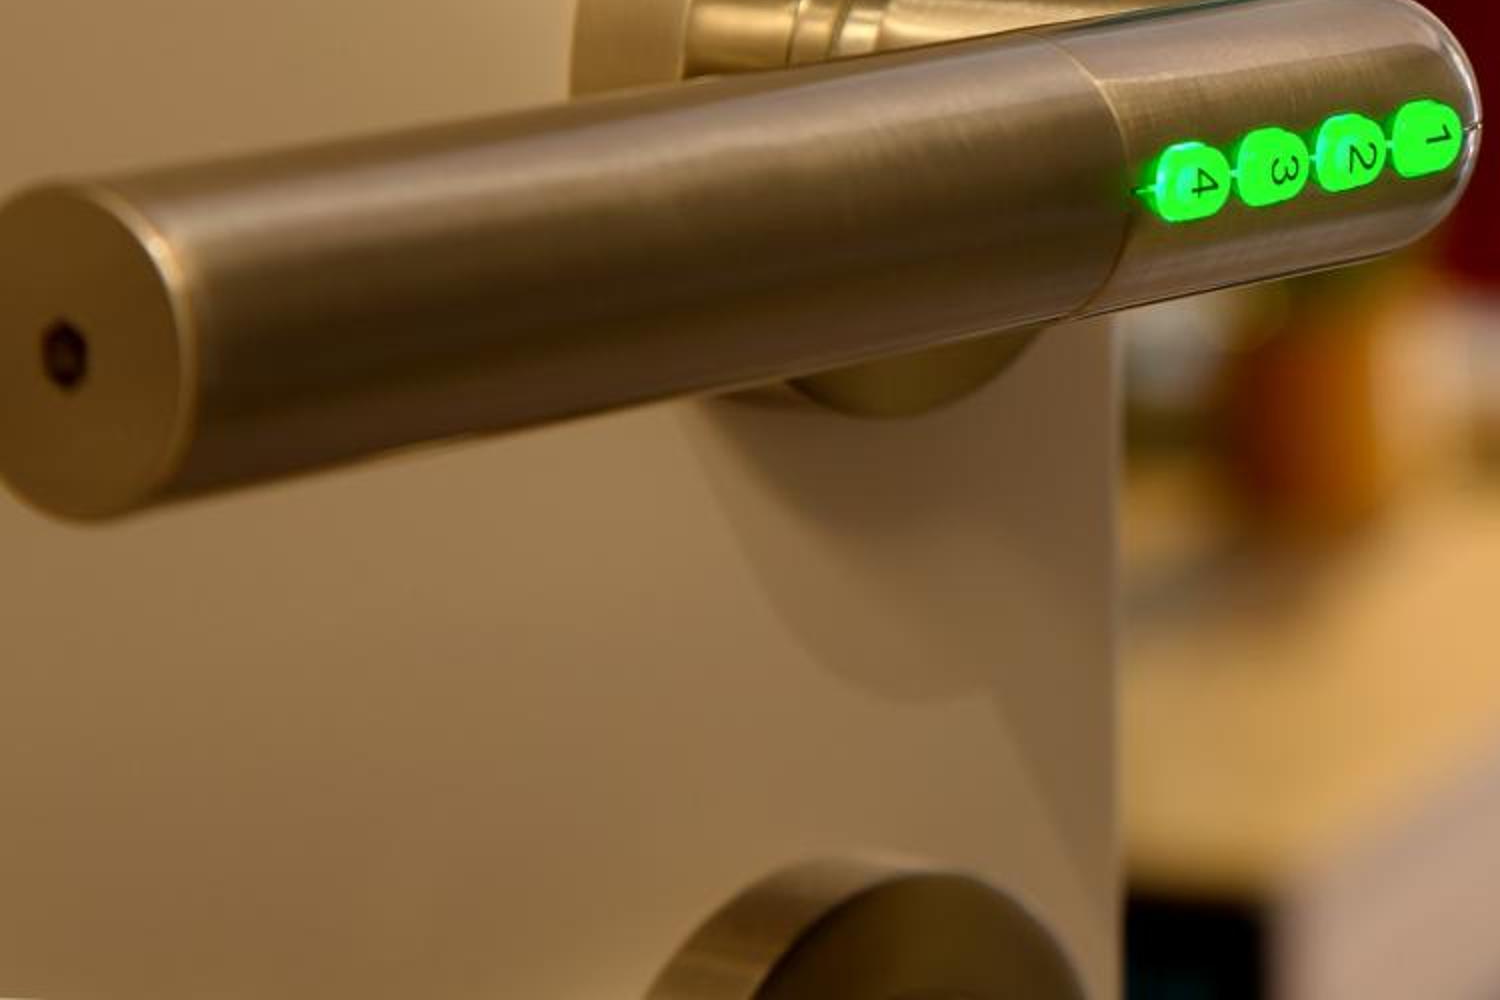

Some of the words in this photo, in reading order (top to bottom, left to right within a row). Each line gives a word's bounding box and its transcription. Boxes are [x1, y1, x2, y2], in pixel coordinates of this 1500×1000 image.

[1425, 124, 1452, 145] 1
[1271, 155, 1299, 185] 3
[1349, 142, 1377, 173] 2
[1191, 167, 1219, 199] 4
